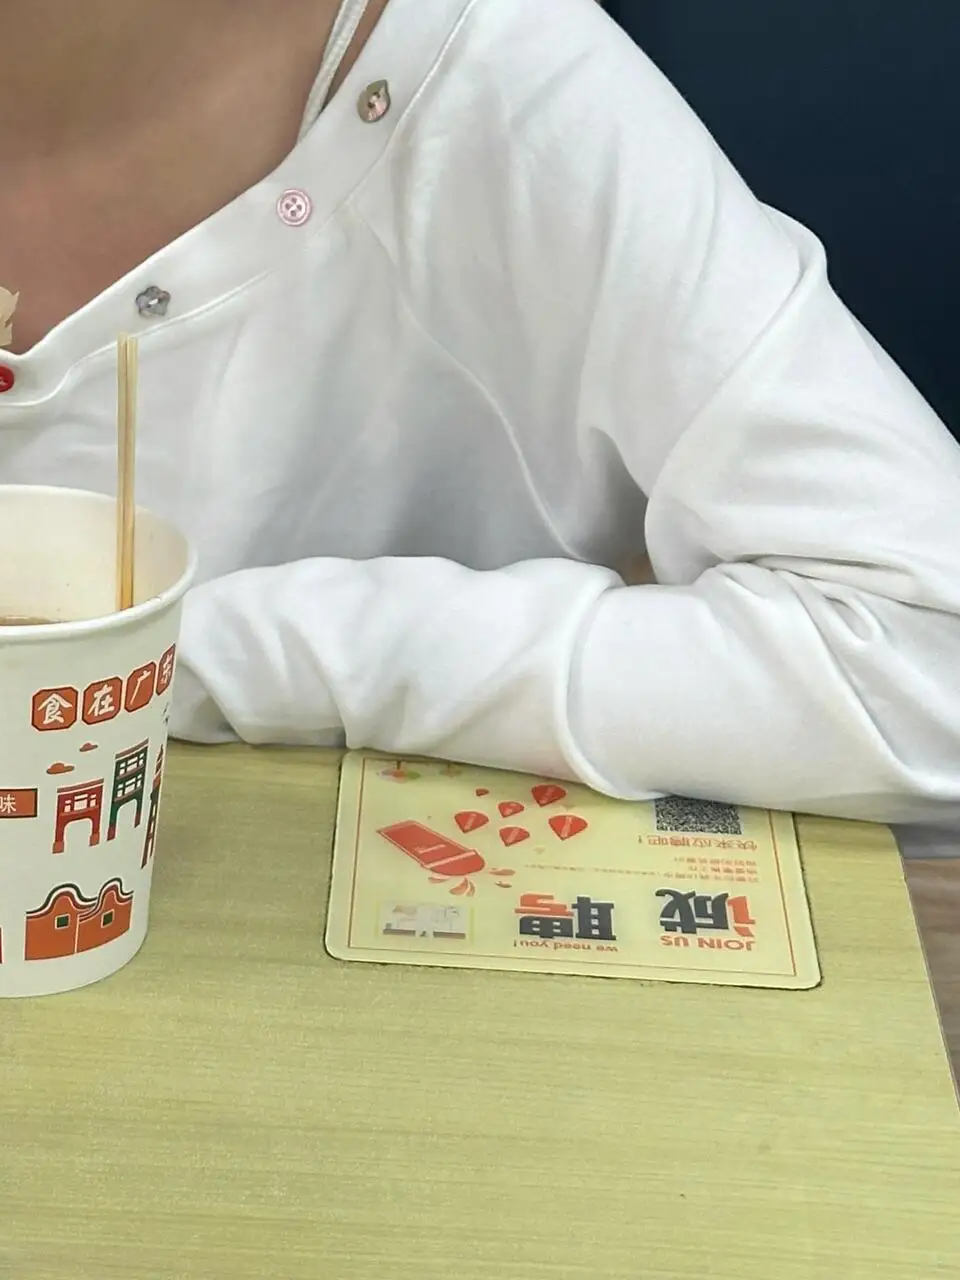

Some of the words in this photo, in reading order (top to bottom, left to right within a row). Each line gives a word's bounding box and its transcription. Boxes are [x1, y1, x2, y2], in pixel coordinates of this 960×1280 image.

[514, 889, 756, 937] 诚聘
[513, 938, 549, 950] you!
[553, 941, 591, 951] need
[660, 935, 689, 948] US
[697, 937, 756, 952] JOIN
